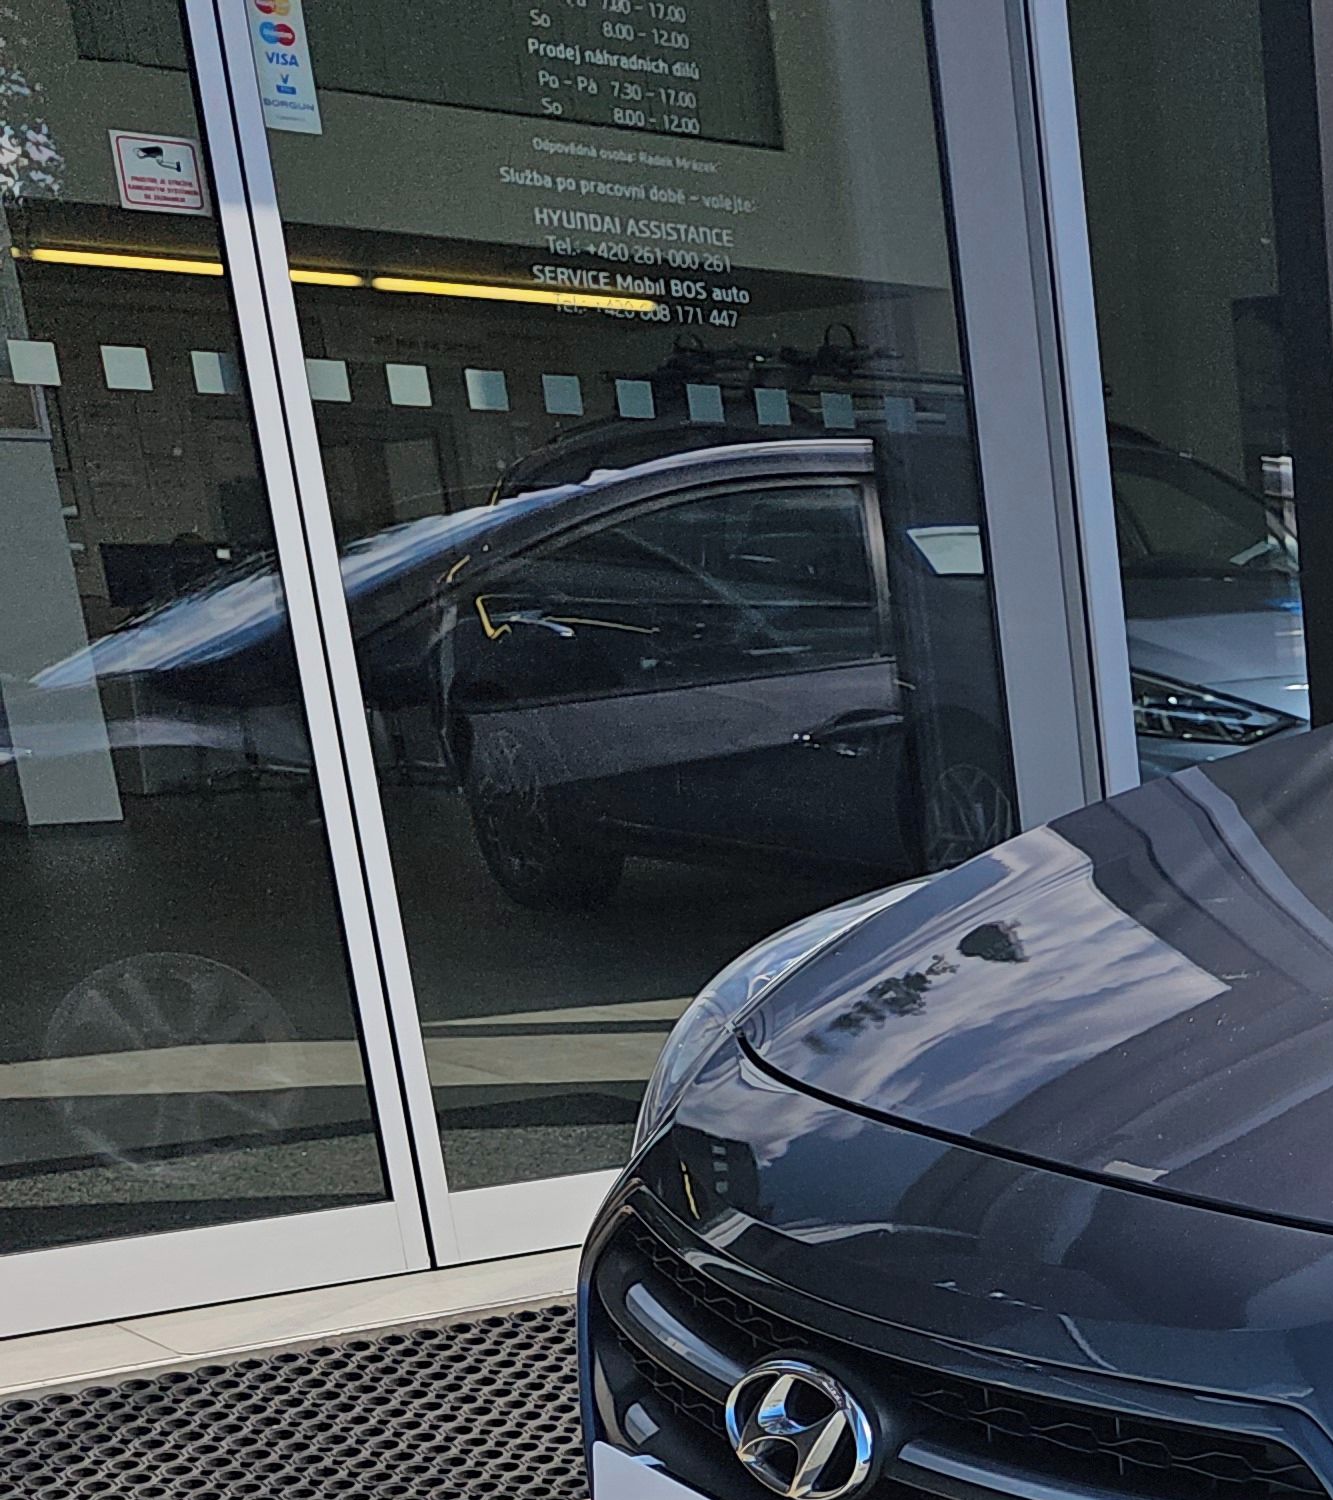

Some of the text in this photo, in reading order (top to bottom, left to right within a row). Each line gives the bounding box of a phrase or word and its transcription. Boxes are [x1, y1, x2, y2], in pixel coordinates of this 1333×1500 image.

[529, 9, 551, 28] So
[602, 21, 634, 41] 8.00
[652, 28, 690, 50] 12.00
[648, 2, 687, 23] 17.00
[265, 51, 299, 67] VISA
[527, 38, 581, 65] Prodej
[585, 49, 669, 75] náhradních
[538, 70, 560, 89] Po
[577, 75, 598, 95] Pá
[611, 81, 642, 100] 7.30
[660, 88, 697, 109] 17.00
[541, 97, 563, 115] So
[613, 107, 645, 127] 8.00
[663, 114, 700, 135] 12.00
[499, 166, 552, 189] Služba
[556, 177, 576, 193] po
[580, 178, 646, 200] pracovní
[650, 185, 686, 205] době
[533, 207, 735, 247] HYUNDAI ASSISTANCE
[587, 242, 629, 262] +420
[634, 245, 662, 265] 261
[668, 249, 700, 271] 000
[703, 253, 732, 273] 261
[532, 265, 750, 304] SERVICE Mobil BOS auto
[676, 305, 704, 325] 171
[709, 309, 738, 328] 447
